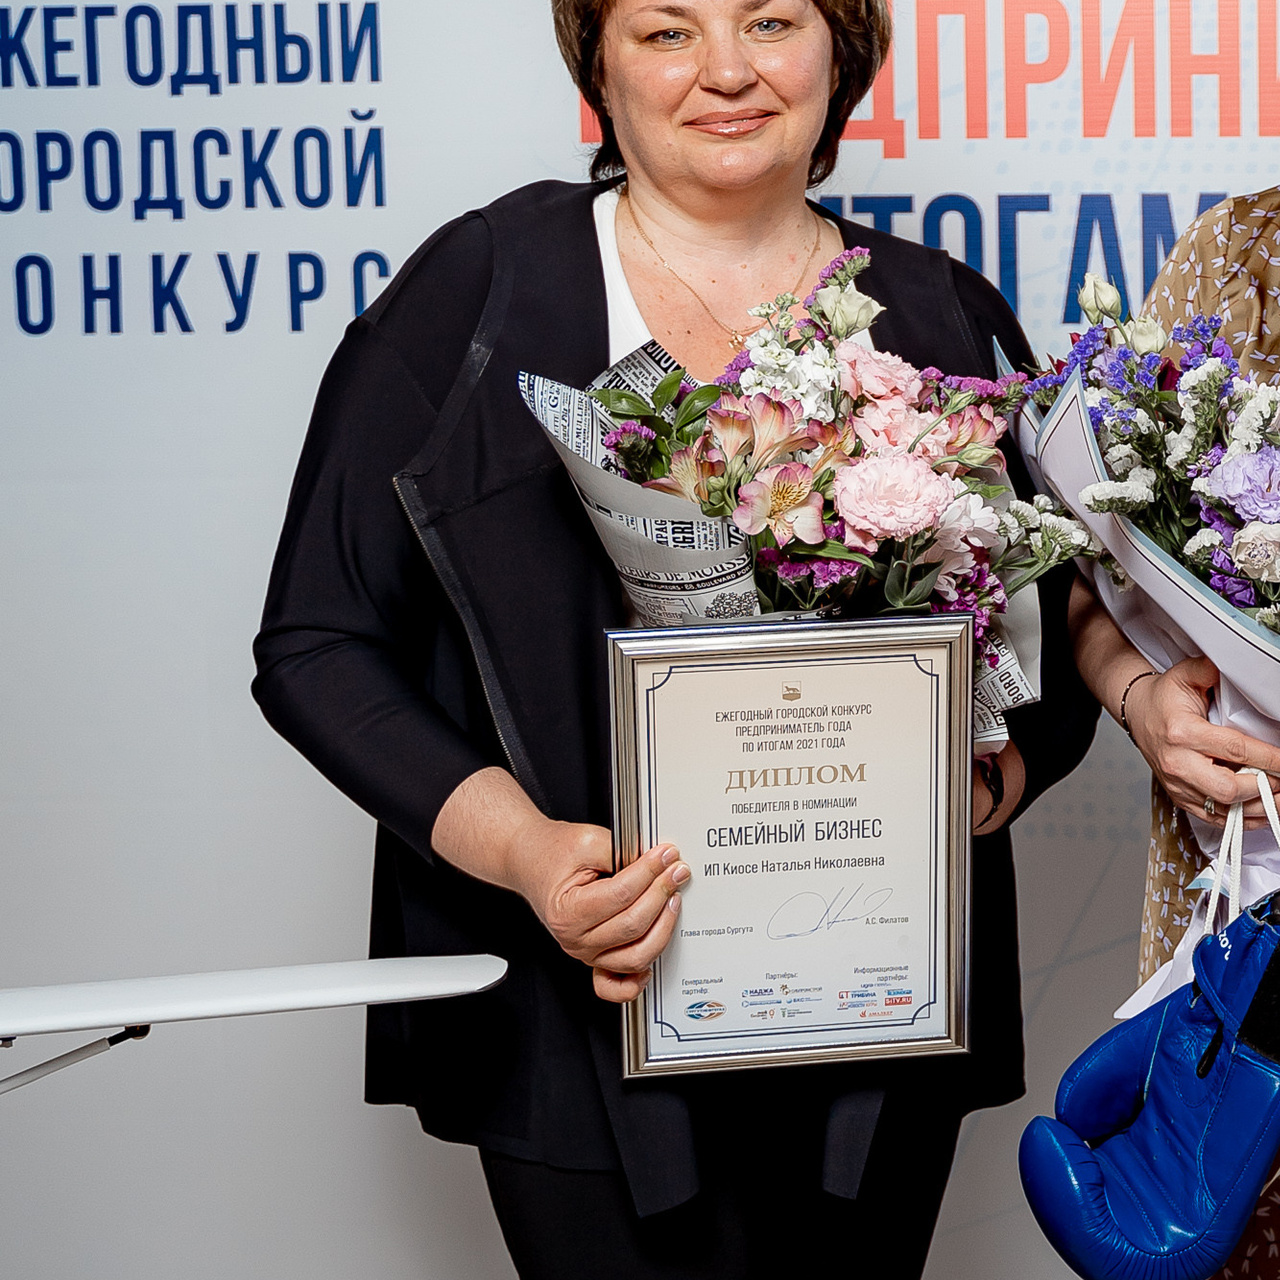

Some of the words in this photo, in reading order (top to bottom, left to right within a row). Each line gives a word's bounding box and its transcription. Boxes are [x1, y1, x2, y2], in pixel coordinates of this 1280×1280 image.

[0, 108, 387, 222] ОРОДСКОЙ
[15, 250, 391, 336] ОНКУРС
[999, 670, 1026, 705] BORD
[715, 707, 773, 723] ЕЖЕГОДНЫЙ
[775, 705, 828, 720] ГОРОДСКОЙ
[831, 703, 872, 717] КОНКУРС
[735, 722, 825, 737] ПРЕДПРИНИМАТЕЛЬ
[828, 720, 852, 733] ГОДА
[742, 742, 755, 753] ПО
[757, 740, 794, 752] ИТОГАМ
[796, 738, 818, 750] 2021
[821, 737, 846, 749] ГОДА
[725, 763, 867, 794] ДИПЛОМ
[731, 800, 790, 815] ПОБЕДИТЕЛЯ
[793, 800, 799, 811] В
[802, 797, 857, 811] НОМИНАЦИИ
[707, 819, 805, 848] СЕМЕЙНЫЙ
[815, 818, 882, 841] БИЗНЕС
[704, 863, 720, 877] ИП
[723, 862, 758, 875] Киосе
[761, 859, 811, 873] Наталья
[814, 856, 885, 870] Николаевна
[865, 916, 877, 926] А.С.
[879, 915, 909, 925] Филатов
[680, 929, 700, 938] Глава
[701, 927, 726, 937] города
[726, 925, 754, 936] Сургута
